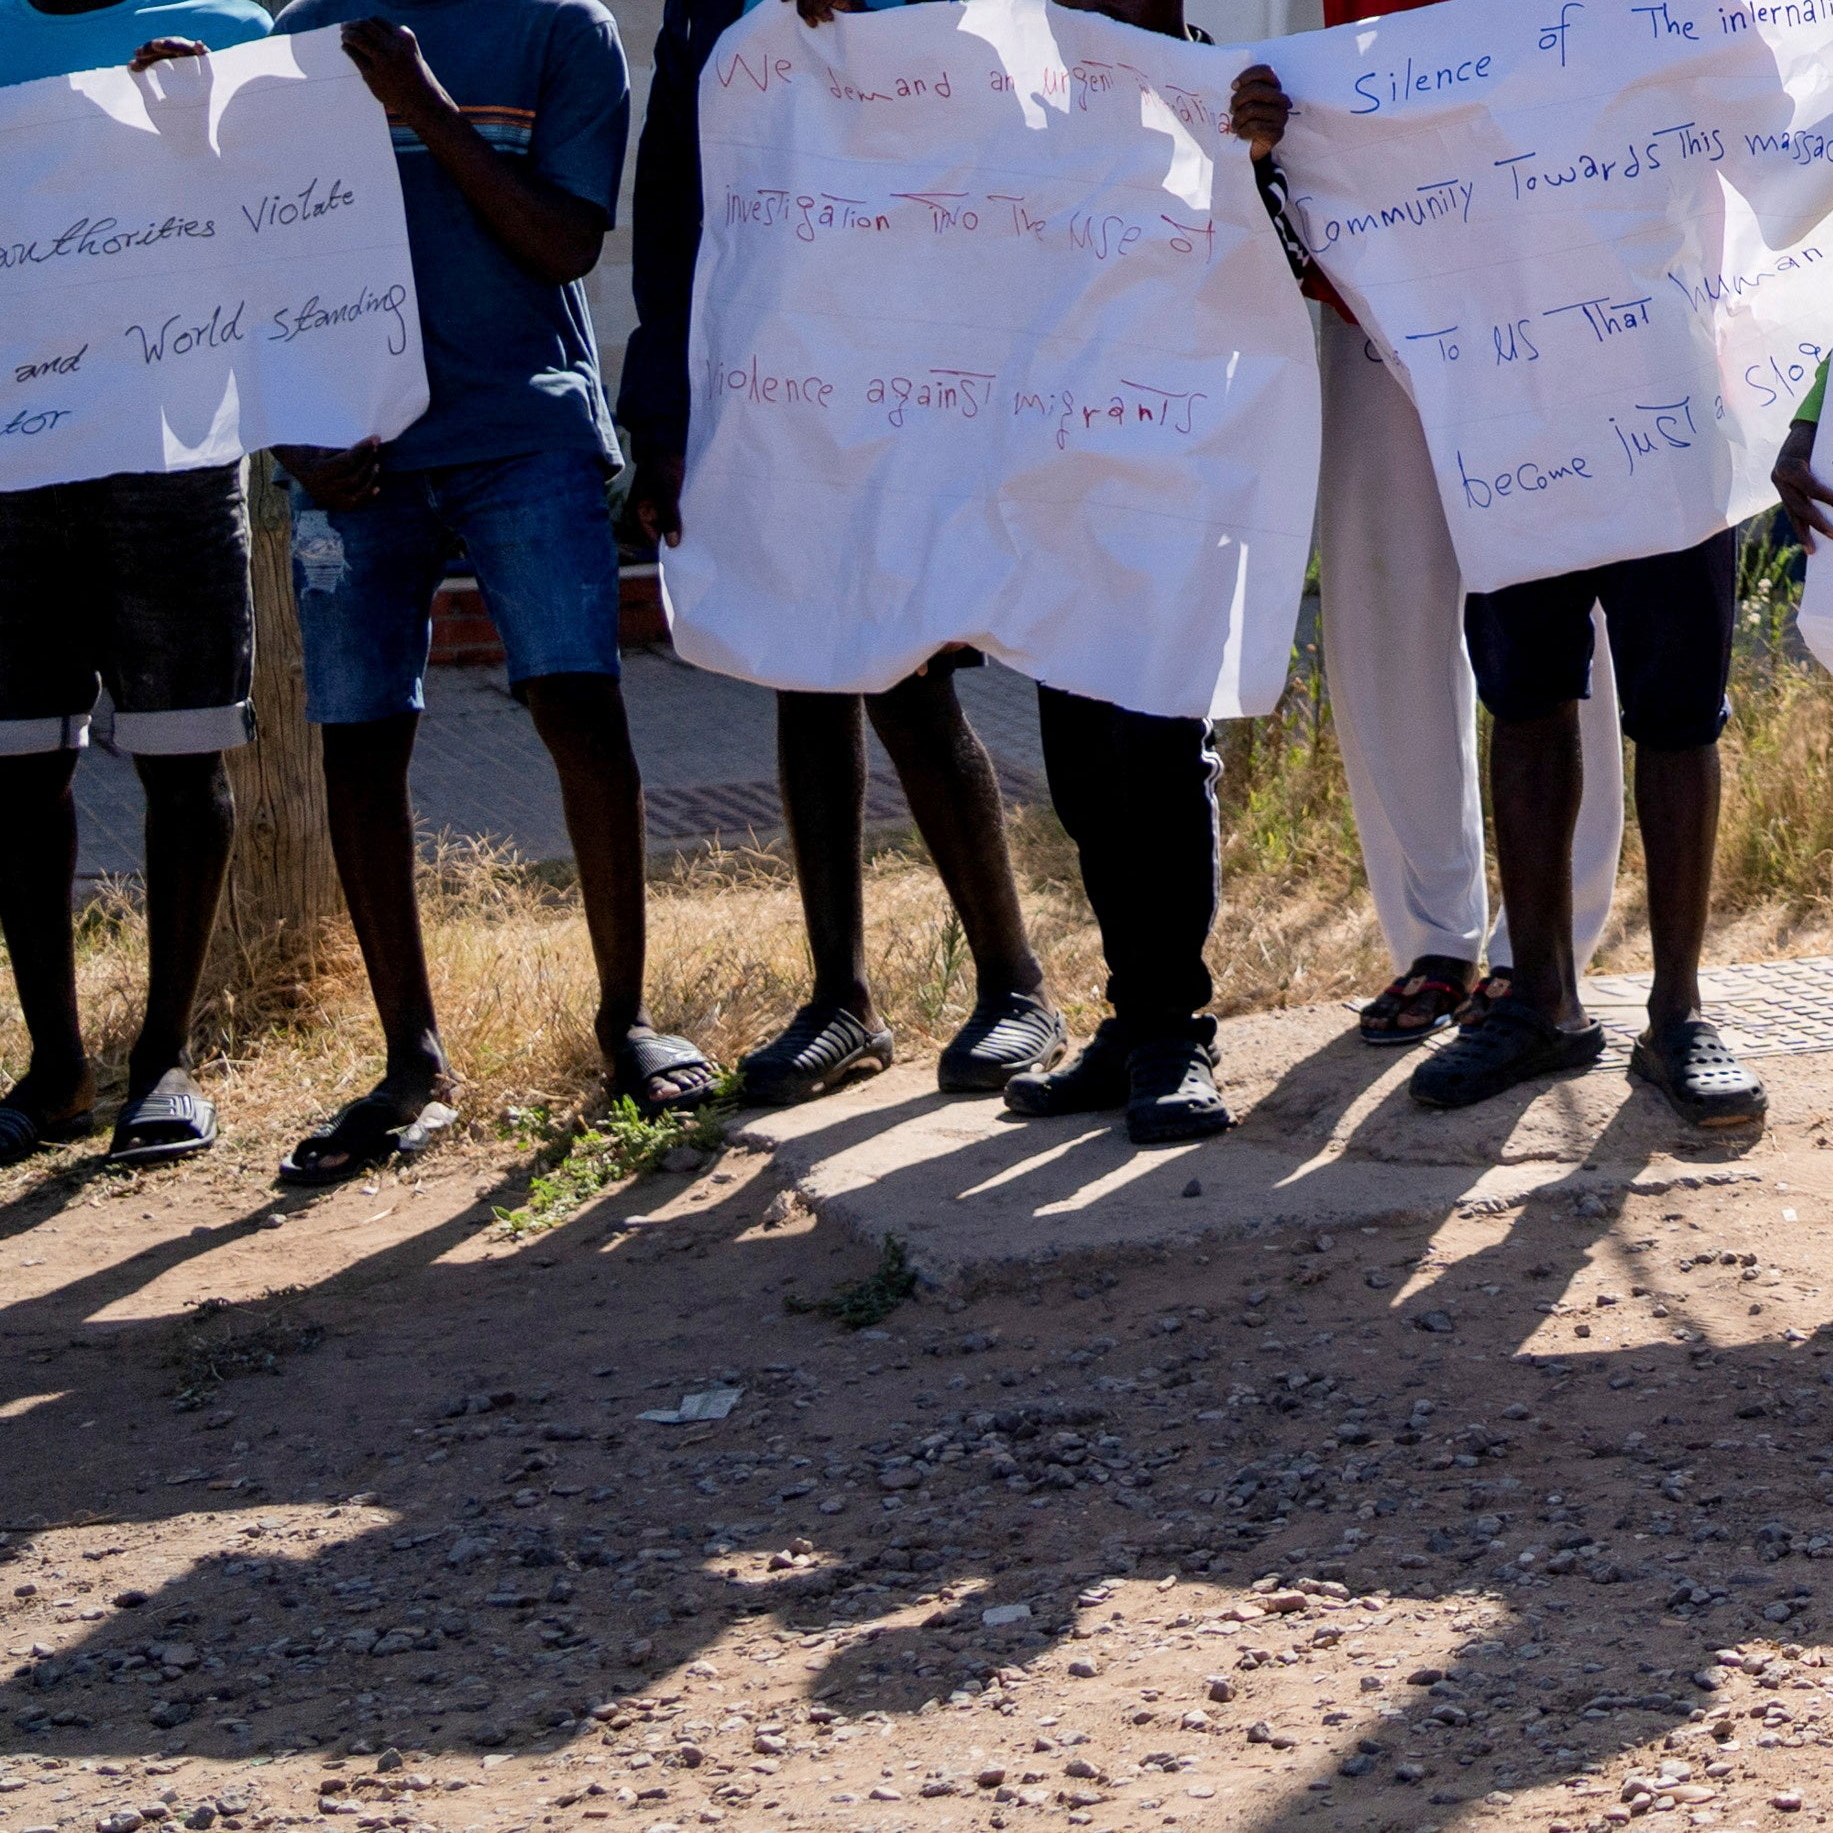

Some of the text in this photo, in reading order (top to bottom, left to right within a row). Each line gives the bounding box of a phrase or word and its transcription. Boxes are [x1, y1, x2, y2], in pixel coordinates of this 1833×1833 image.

[715, 50, 793, 92] We
[827, 66, 951, 102] demand
[989, 70, 1016, 92] an
[1350, 55, 1492, 114] Silence
[1537, 2, 1585, 67] of
[15, 343, 89, 383] and
[1714, 395, 1726, 420] a
